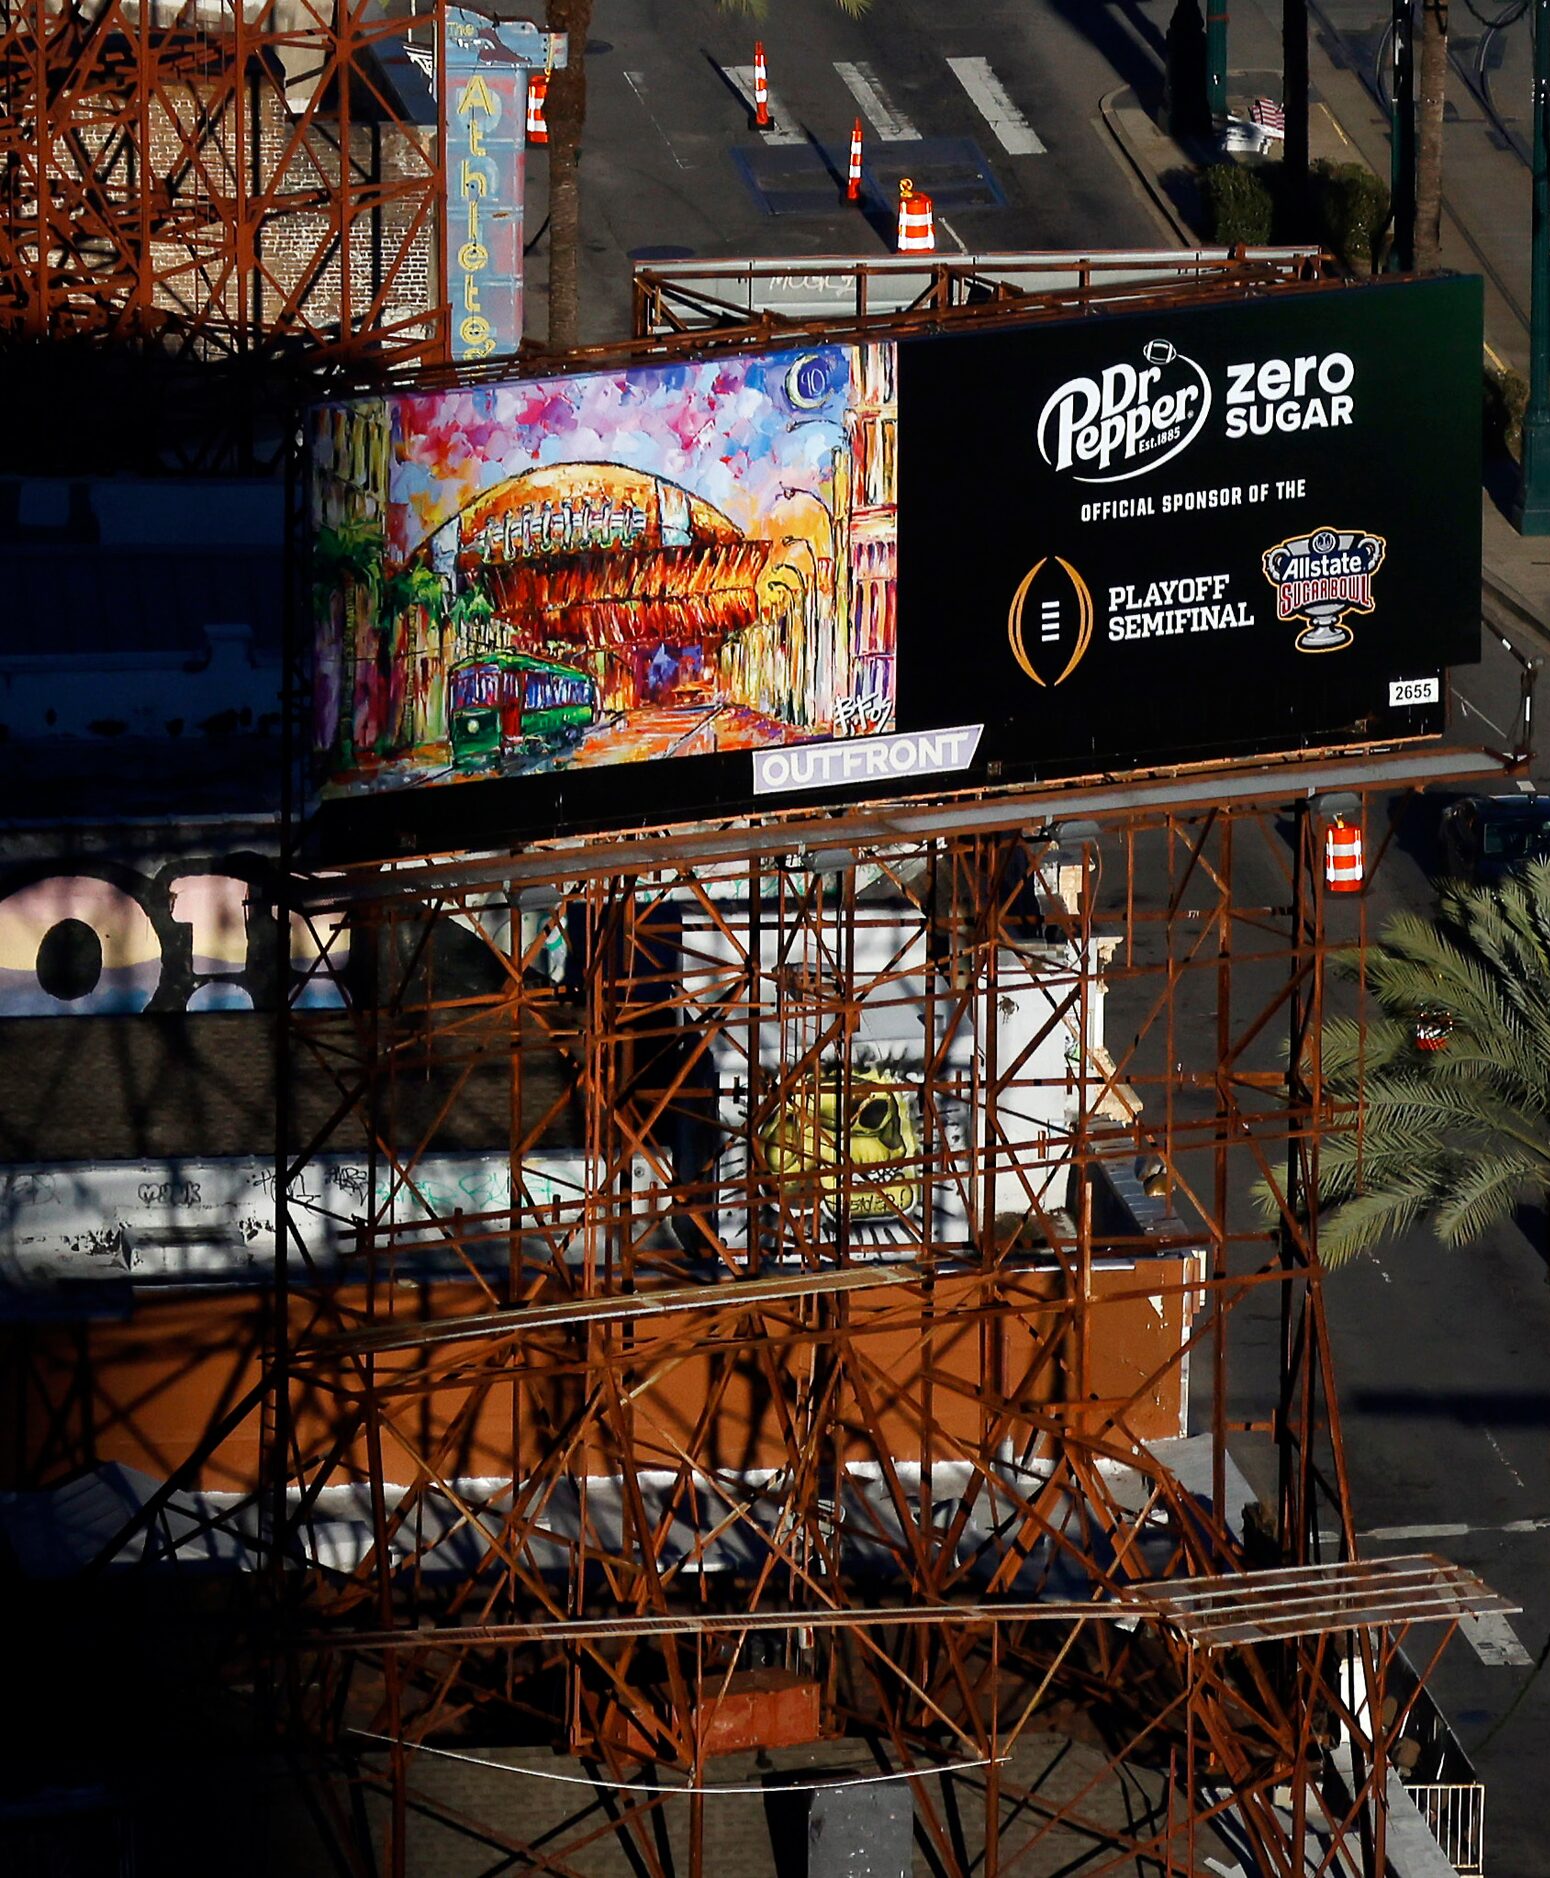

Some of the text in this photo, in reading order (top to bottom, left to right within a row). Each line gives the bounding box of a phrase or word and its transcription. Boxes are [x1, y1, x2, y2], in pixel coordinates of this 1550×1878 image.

[1100, 363, 1161, 420] Dr
[1226, 352, 1355, 405] zero
[1048, 377, 1199, 472] Pepper
[1225, 395, 1354, 438] SUGAR
[1081, 479, 1306, 522] OFFICIAL SPONSOR OF THE
[1282, 552, 1362, 581] Allstate
[1108, 574, 1230, 612] PLAYOFF
[1108, 602, 1255, 641] SEMIFINAL
[1395, 683, 1432, 700] 2655
[762, 732, 969, 787] OUTFRONT
